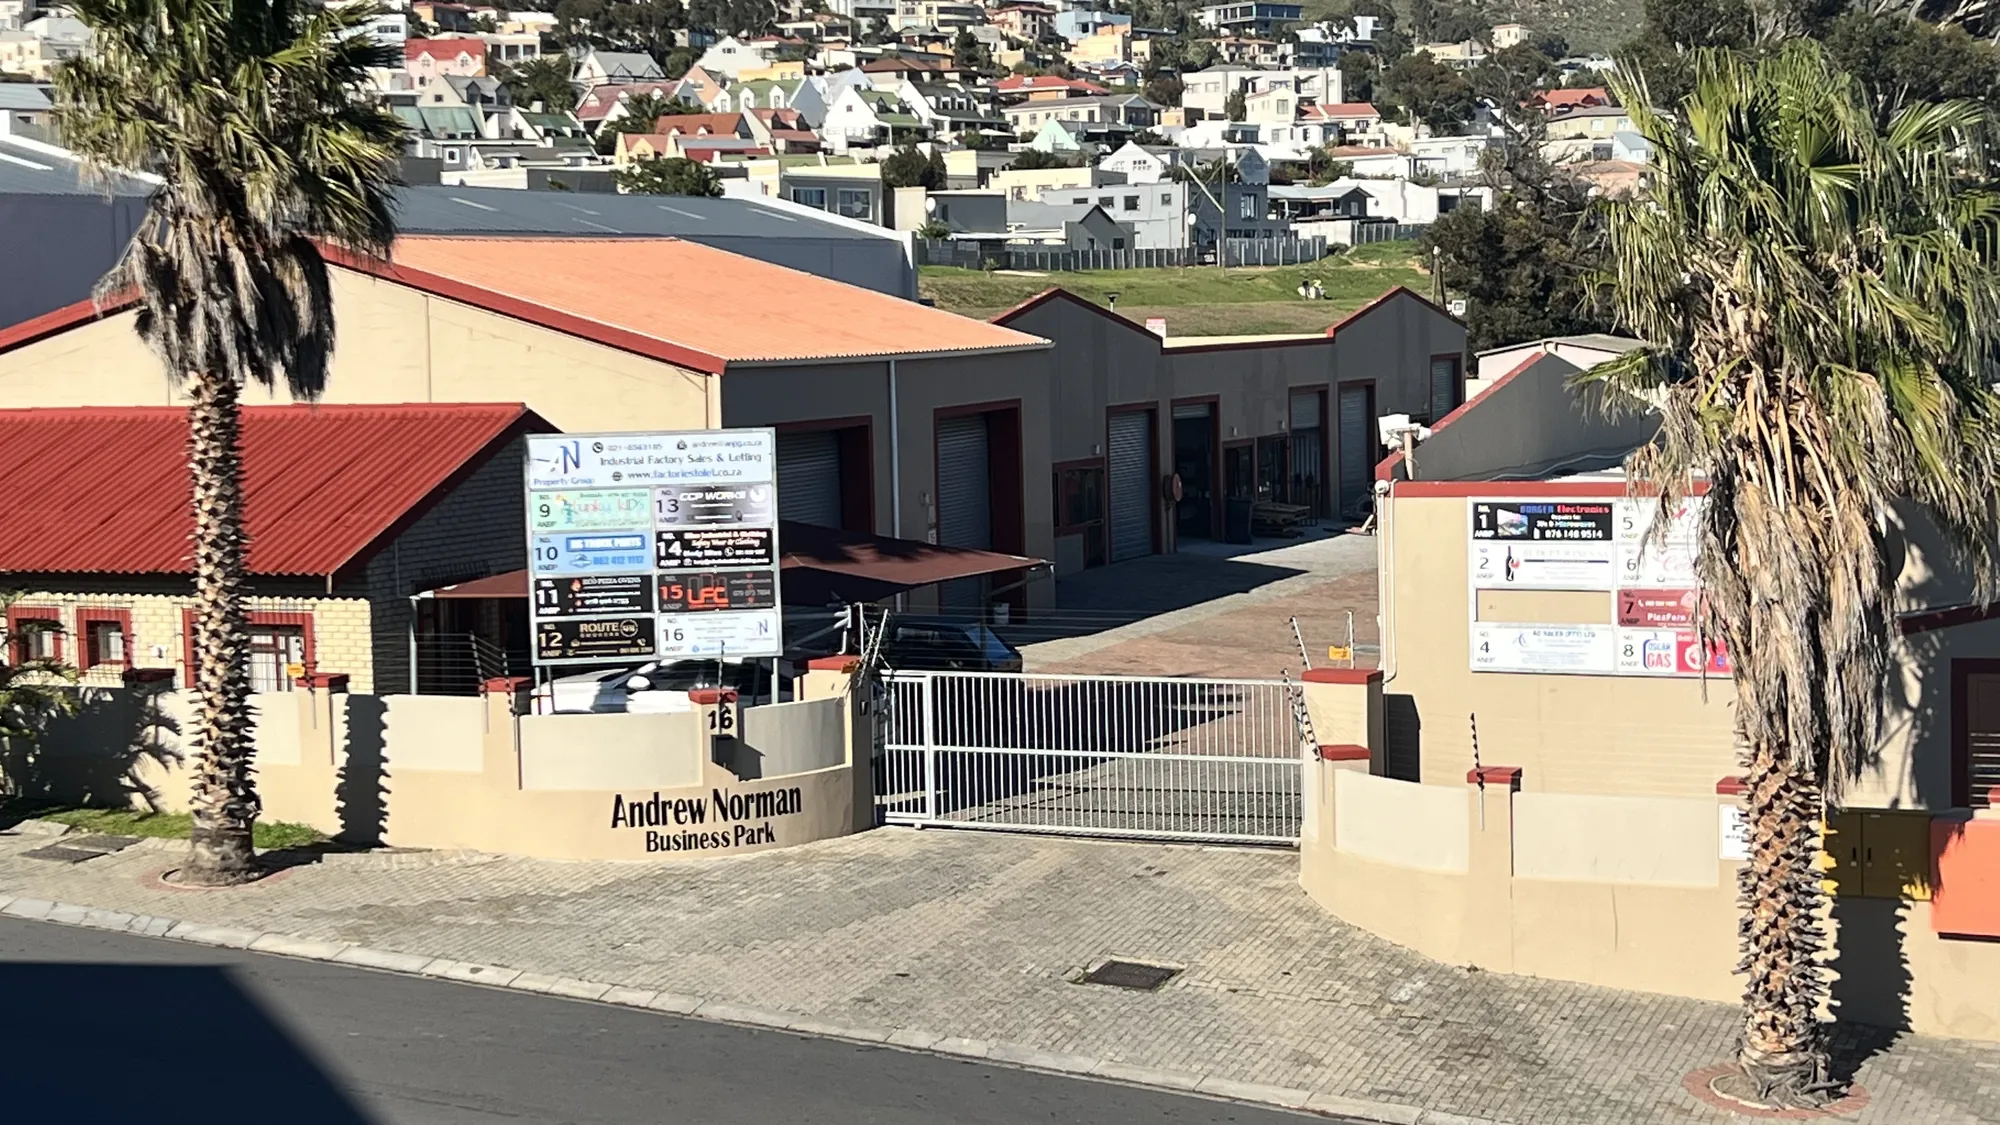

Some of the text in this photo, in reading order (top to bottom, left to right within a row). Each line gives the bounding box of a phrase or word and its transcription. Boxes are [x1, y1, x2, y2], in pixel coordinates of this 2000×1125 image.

[600, 456, 644, 466] Industrial
[648, 455, 684, 465] Factory
[688, 454, 713, 463] Sales
[716, 453, 724, 462] &
[539, 503, 551, 518] 9
[656, 498, 679, 513] 13
[1557, 504, 1610, 514] Electronics
[1479, 514, 1488, 529] 1
[1623, 516, 1633, 530] 5
[535, 546, 558, 561] 10
[657, 540, 682, 556] 14
[1479, 557, 1489, 569] 2
[1626, 558, 1637, 571] 6
[536, 589, 558, 604] 11
[659, 584, 684, 600] 15
[1624, 601, 1634, 614] 7
[579, 622, 619, 633] ROUTE
[663, 627, 684, 641] 16
[539, 632, 562, 647] 12
[1479, 640, 1490, 653] 4
[1623, 644, 1634, 657] 8
[1647, 653, 1672, 668] GAS
[707, 709, 734, 730] 16
[611, 786, 802, 829] Andrew Norman
[646, 822, 776, 853] Business Park
